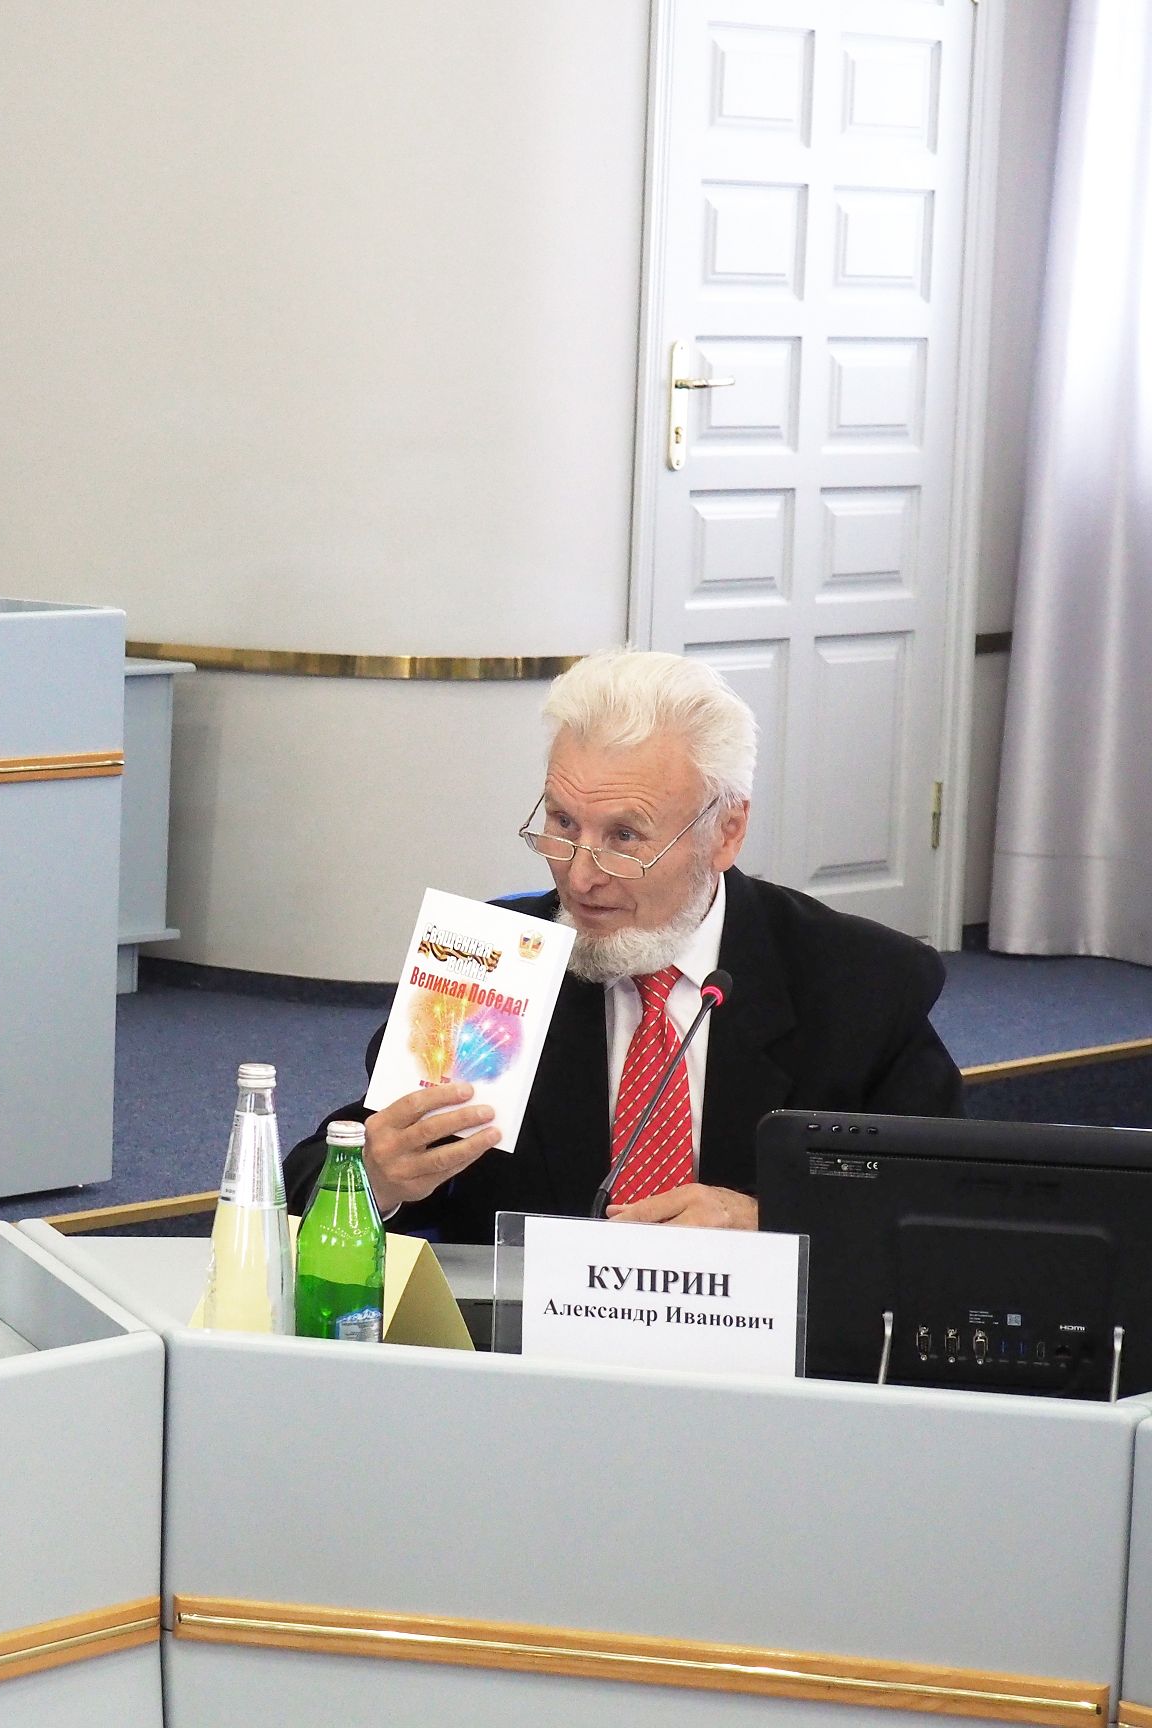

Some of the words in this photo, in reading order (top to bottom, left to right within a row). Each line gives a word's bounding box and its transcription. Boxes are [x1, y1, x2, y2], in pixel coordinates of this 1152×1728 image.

[409, 966, 467, 999] Великая
[467, 982, 529, 1017] Победа!
[586, 1264, 731, 1297] КУПРИН
[543, 1298, 658, 1326] Александр
[665, 1306, 775, 1330] Иванович
[1059, 1324, 1086, 1332] HDMI
